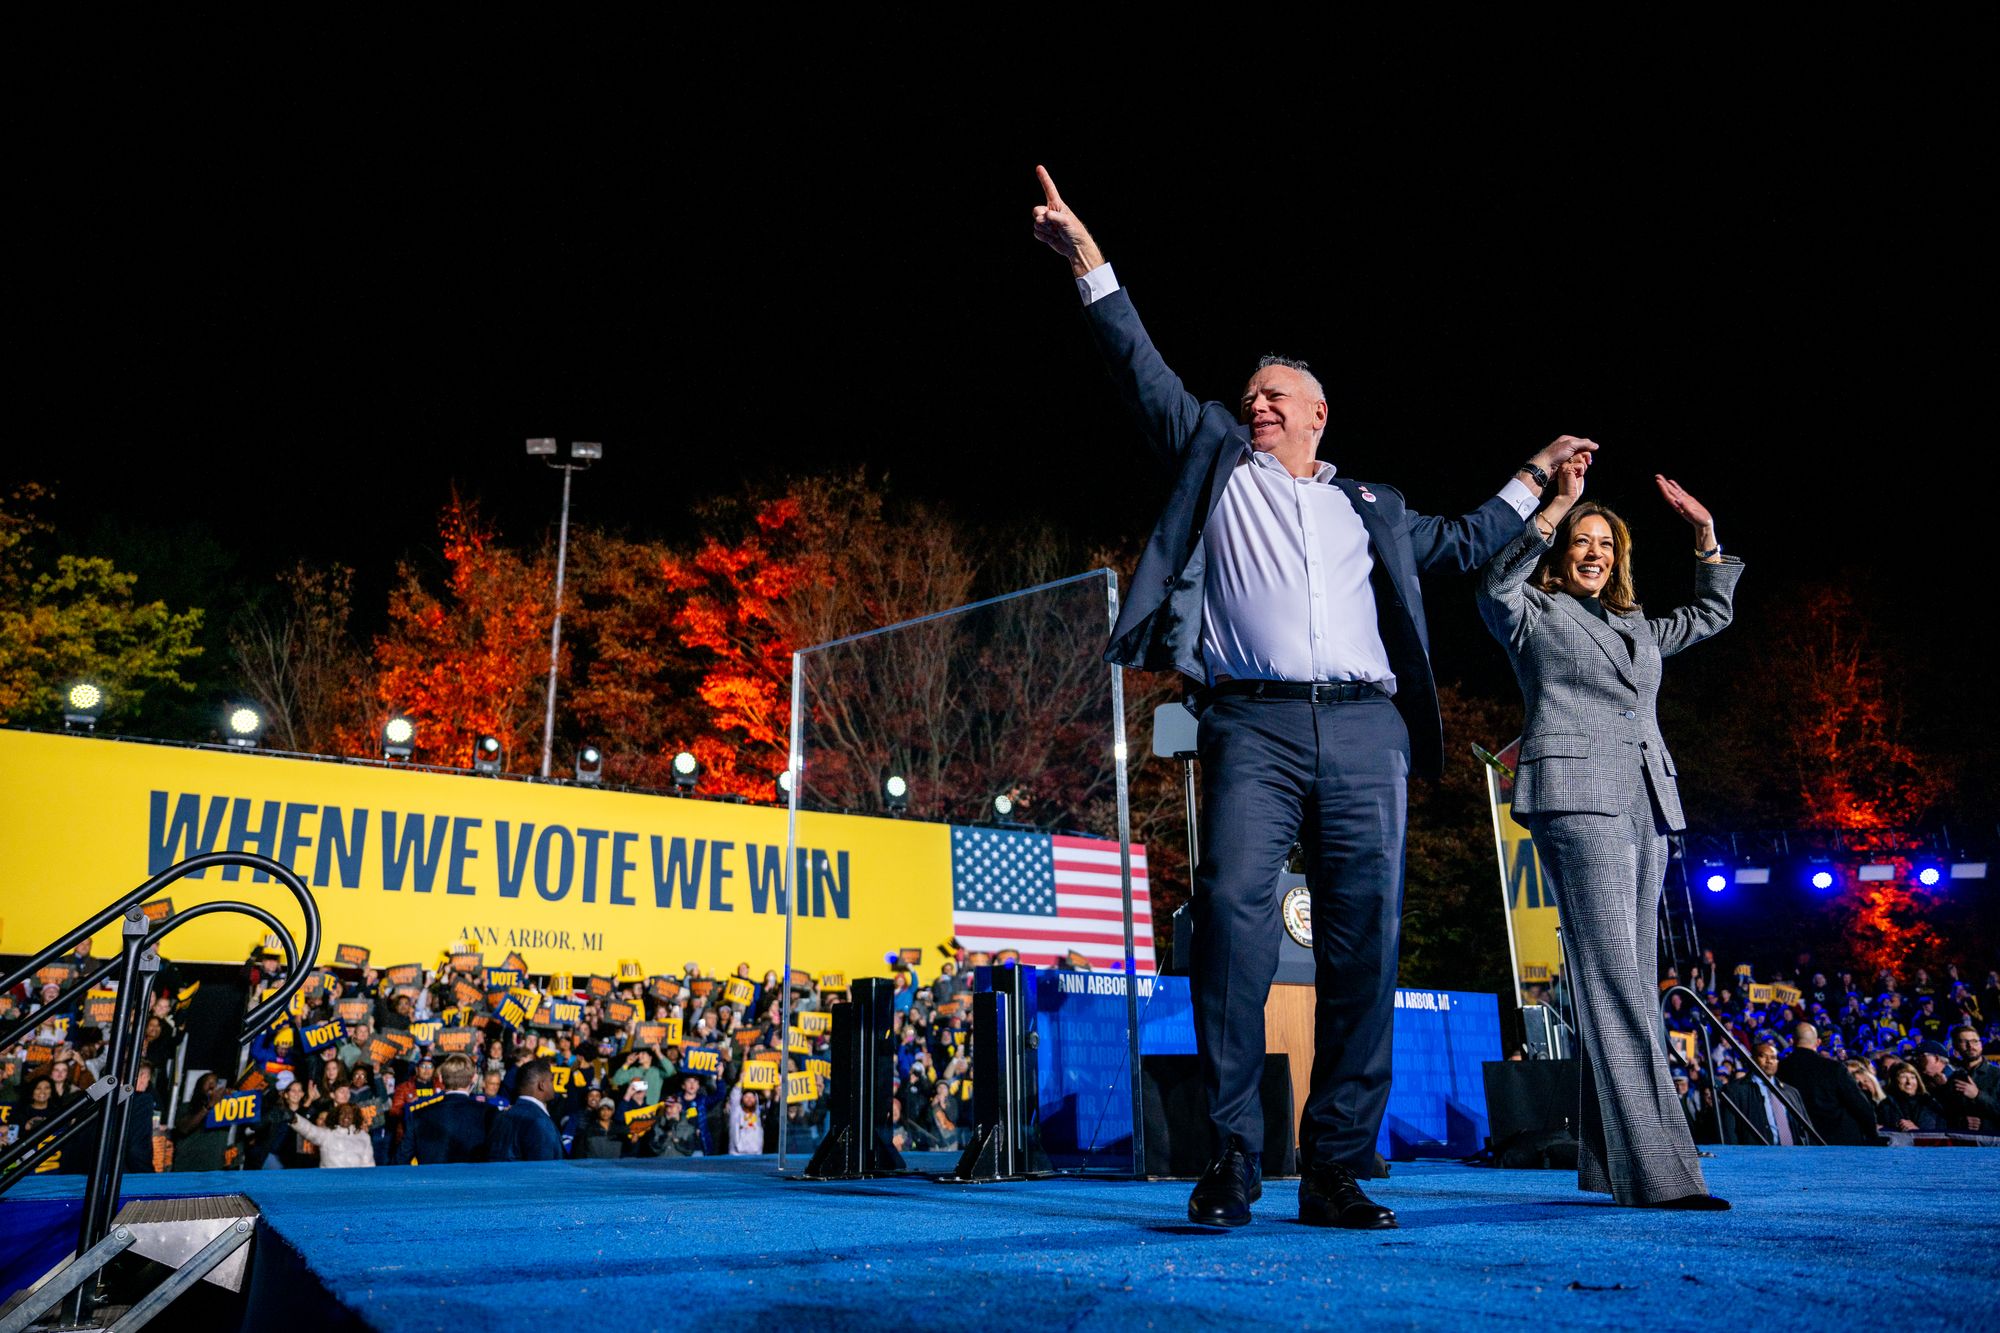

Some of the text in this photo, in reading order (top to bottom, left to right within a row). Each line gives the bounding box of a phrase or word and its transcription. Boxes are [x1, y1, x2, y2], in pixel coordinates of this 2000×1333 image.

[148, 790, 850, 919] WHEN WE VOTE WE WIN
[460, 926, 603, 952] ANN ARBOR, MI
[490, 970, 519, 986] VOTE
[621, 961, 642, 978] VOTE
[821, 974, 845, 987] VOTE
[1057, 973, 1154, 997] ANN ARBOR MI
[729, 983, 751, 1001] VOTE
[1753, 988, 1772, 999] VOTE
[1775, 990, 1796, 1002] VOTE
[1405, 991, 1438, 1012] ARBOR,
[1438, 993, 1450, 1010] MI
[500, 998, 524, 1030] VOTE
[554, 1003, 582, 1021] VOTE
[409, 1022, 443, 1041] VOT
[803, 1016, 829, 1031] VOTE
[305, 1020, 344, 1048] VOTE
[687, 1049, 719, 1071] VOTE
[749, 1066, 776, 1084] VOTE
[214, 1094, 257, 1123] VOTE
